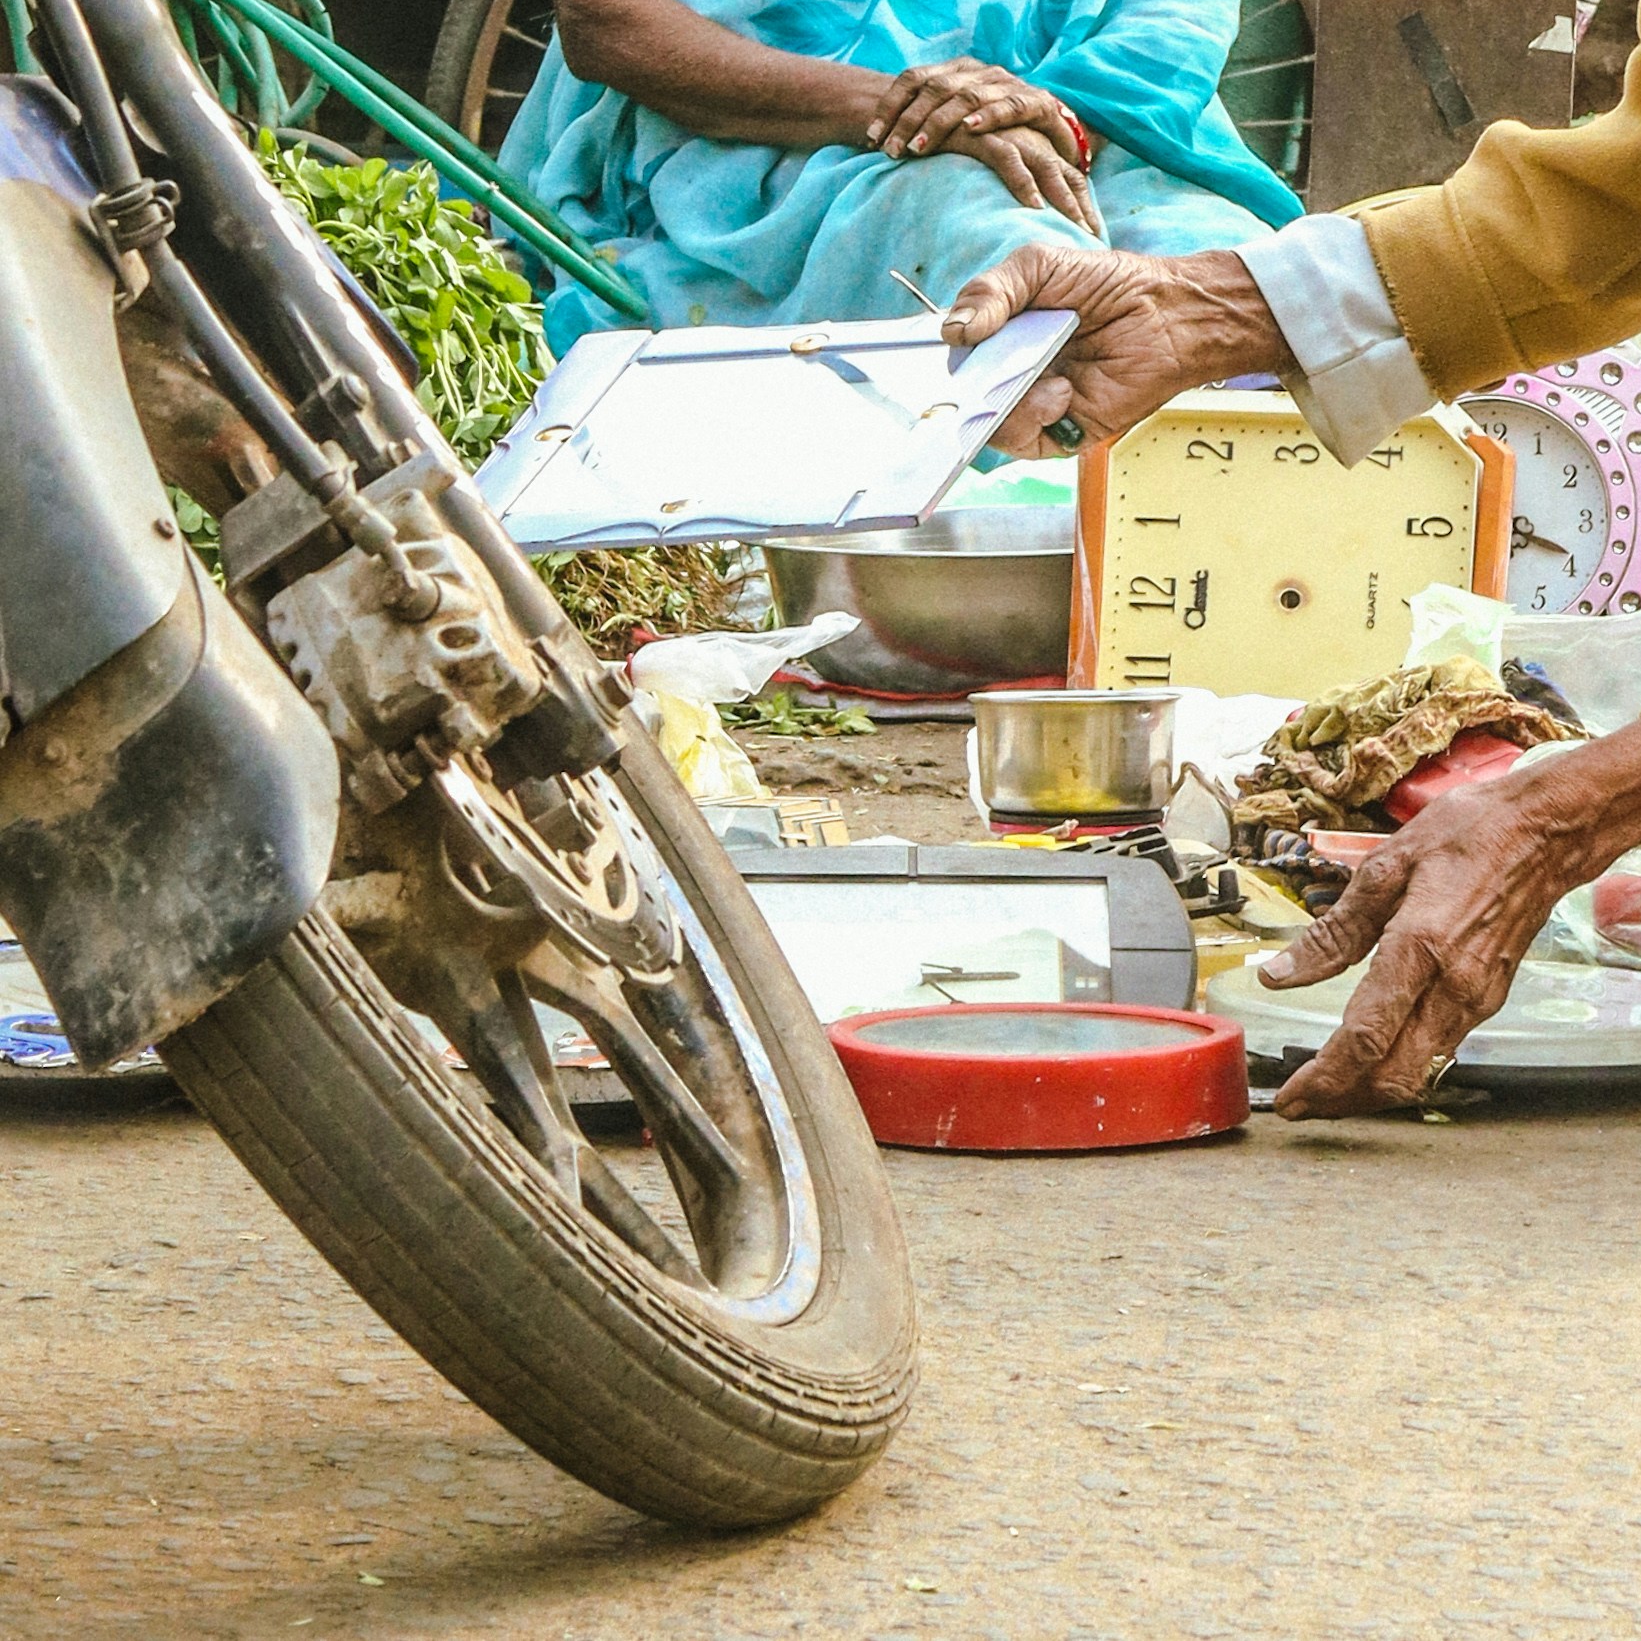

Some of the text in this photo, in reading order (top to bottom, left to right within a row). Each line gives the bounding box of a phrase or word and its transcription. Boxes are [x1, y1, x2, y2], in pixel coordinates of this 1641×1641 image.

[1185, 439, 1235, 462] 2
[1273, 442, 1321, 466] 3
[1533, 432, 1545, 456] 1
[1562, 463, 1579, 489] 2
[1133, 513, 1182, 530] 1
[1405, 515, 1454, 540] 5
[1577, 508, 1595, 534] 3
[1562, 552, 1578, 579] 4
[1127, 573, 1178, 615] 12
[1365, 571, 1380, 631] QUARTZ
[1530, 585, 1547, 611] 5
[1123, 651, 1173, 687] 11
